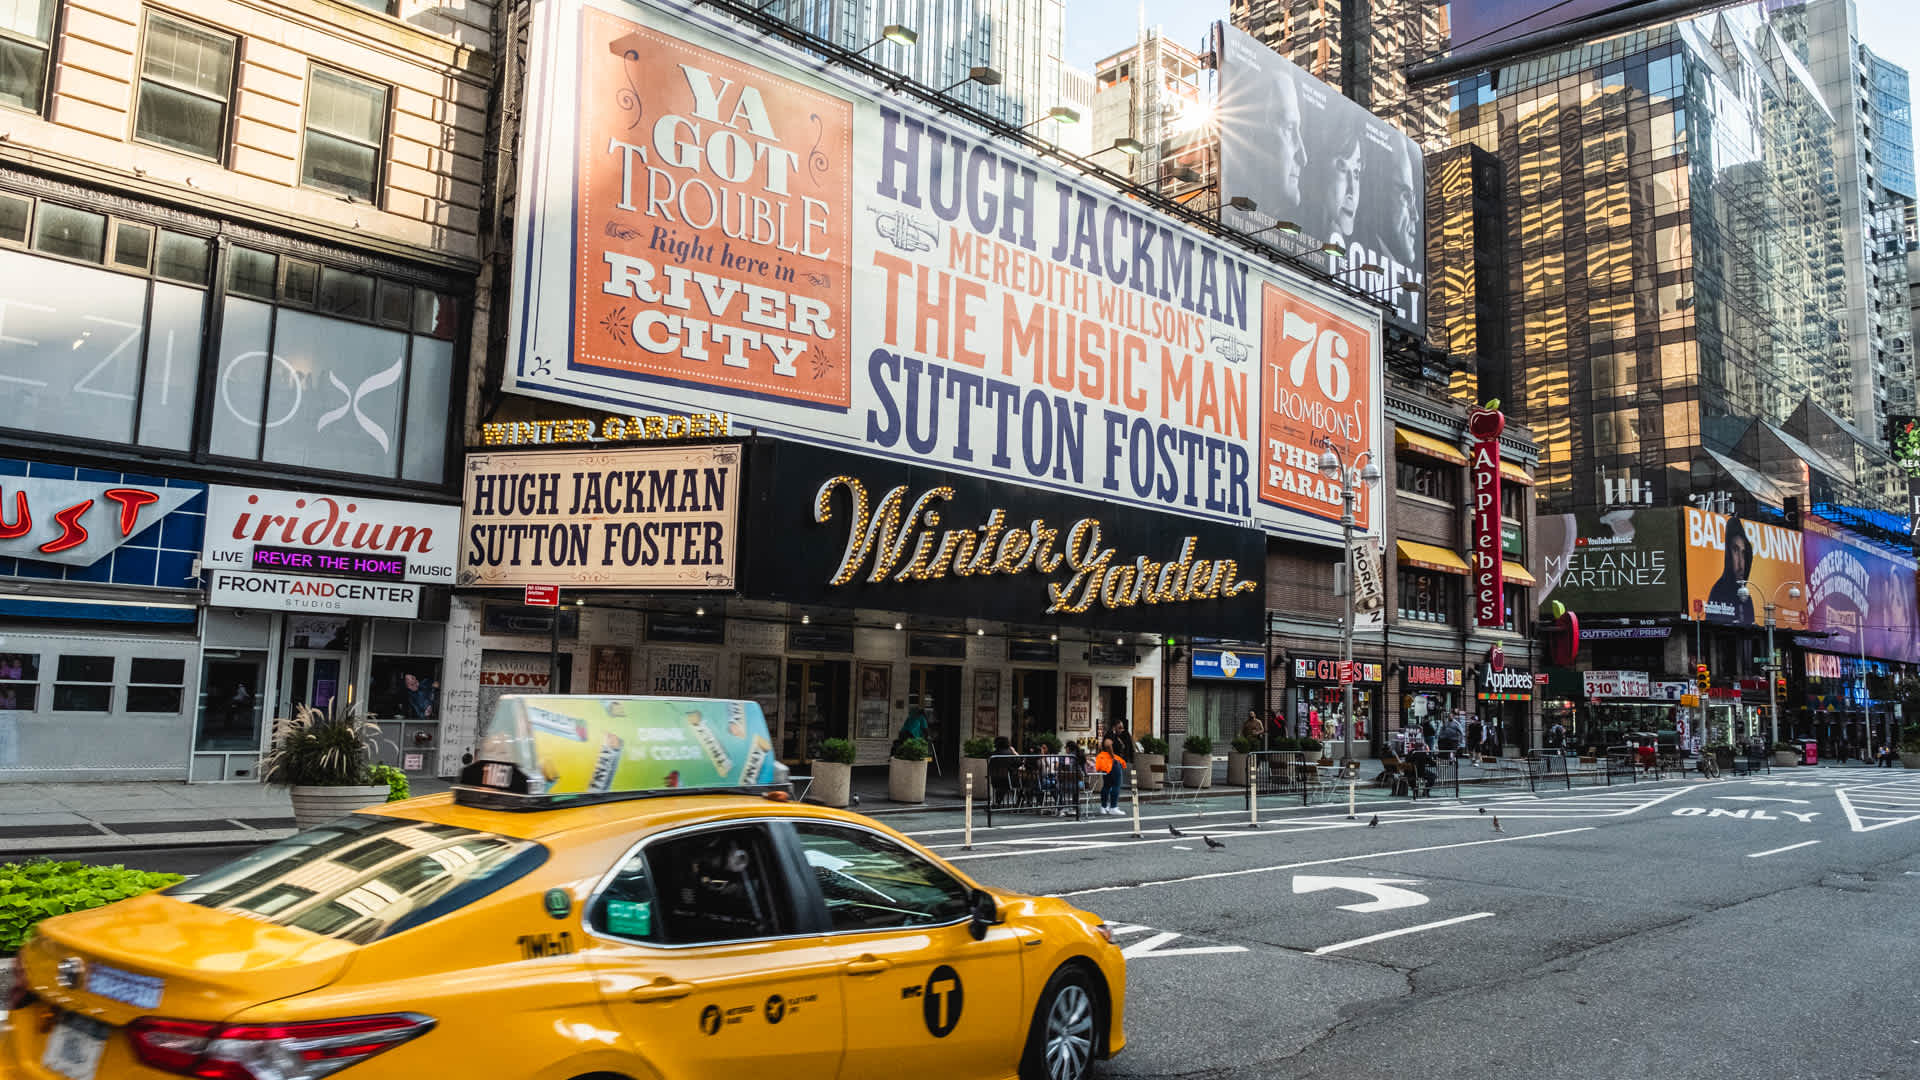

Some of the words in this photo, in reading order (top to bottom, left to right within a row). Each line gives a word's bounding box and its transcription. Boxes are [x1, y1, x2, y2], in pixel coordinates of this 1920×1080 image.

[677, 63, 781, 142] YA
[653, 114, 799, 197] GOT
[608, 137, 831, 261] TROUBLE
[877, 105, 1038, 252] HUGH
[1051, 182, 1248, 331] JACKMAN
[650, 225, 713, 264] Right
[721, 242, 770, 276] here
[775, 258, 795, 283] in
[602, 251, 836, 340] RIVER
[949, 227, 1087, 314] MEREDITH
[1098, 285, 1205, 354] WILLSON'S
[632, 310, 807, 376] CITY
[873, 251, 987, 369] THE
[1001, 293, 1148, 412] MUSIC
[1161, 346, 1249, 441] MAN
[1283, 309, 1350, 402] 76
[1270, 363, 1362, 442] TROMBONES
[483, 417, 594, 445] WINTER
[602, 411, 733, 440] GARDEN
[866, 348, 1088, 483] SUTTON
[1103, 409, 1251, 518] FOSTER
[1269, 438, 1319, 475] THE
[472, 473, 560, 516] HUGH
[569, 467, 728, 514] JACKMAN
[232, 494, 433, 553] iridium
[468, 523, 591, 567] SUTTON
[601, 521, 724, 566] FOSTER
[814, 475, 1063, 586] Winter
[1046, 518, 1257, 614] Garden
[1474, 447, 1495, 621] Applebee's
[1587, 537, 1611, 545] YouTube
[1612, 535, 1633, 544] Music
[1689, 509, 1727, 550] BAD
[1743, 521, 1803, 565] BUNNY
[212, 551, 244, 563] LIVE
[254, 550, 312, 567] REVER
[318, 555, 349, 570] THE
[354, 559, 402, 574] HOME
[409, 564, 452, 577] MUSIC
[1544, 551, 1665, 571] MELANIE
[1544, 568, 1666, 588] MARTINEZ
[1811, 551, 1834, 592] SOURCE
[1845, 551, 1870, 596] SANITY
[218, 575, 414, 603] FRONTANDCENTER
[285, 599, 341, 609] STUDIOS
[480, 671, 550, 687] KNOW
[654, 678, 711, 693] JACKMAN
[669, 664, 699, 679] HUGH
[1318, 660, 1363, 681] GIS
[1408, 665, 1445, 685] LUGGAGE
[1485, 663, 1532, 692] Applebee's
[1671, 808, 1822, 822] ONLY
[932, 978, 956, 1029] T
